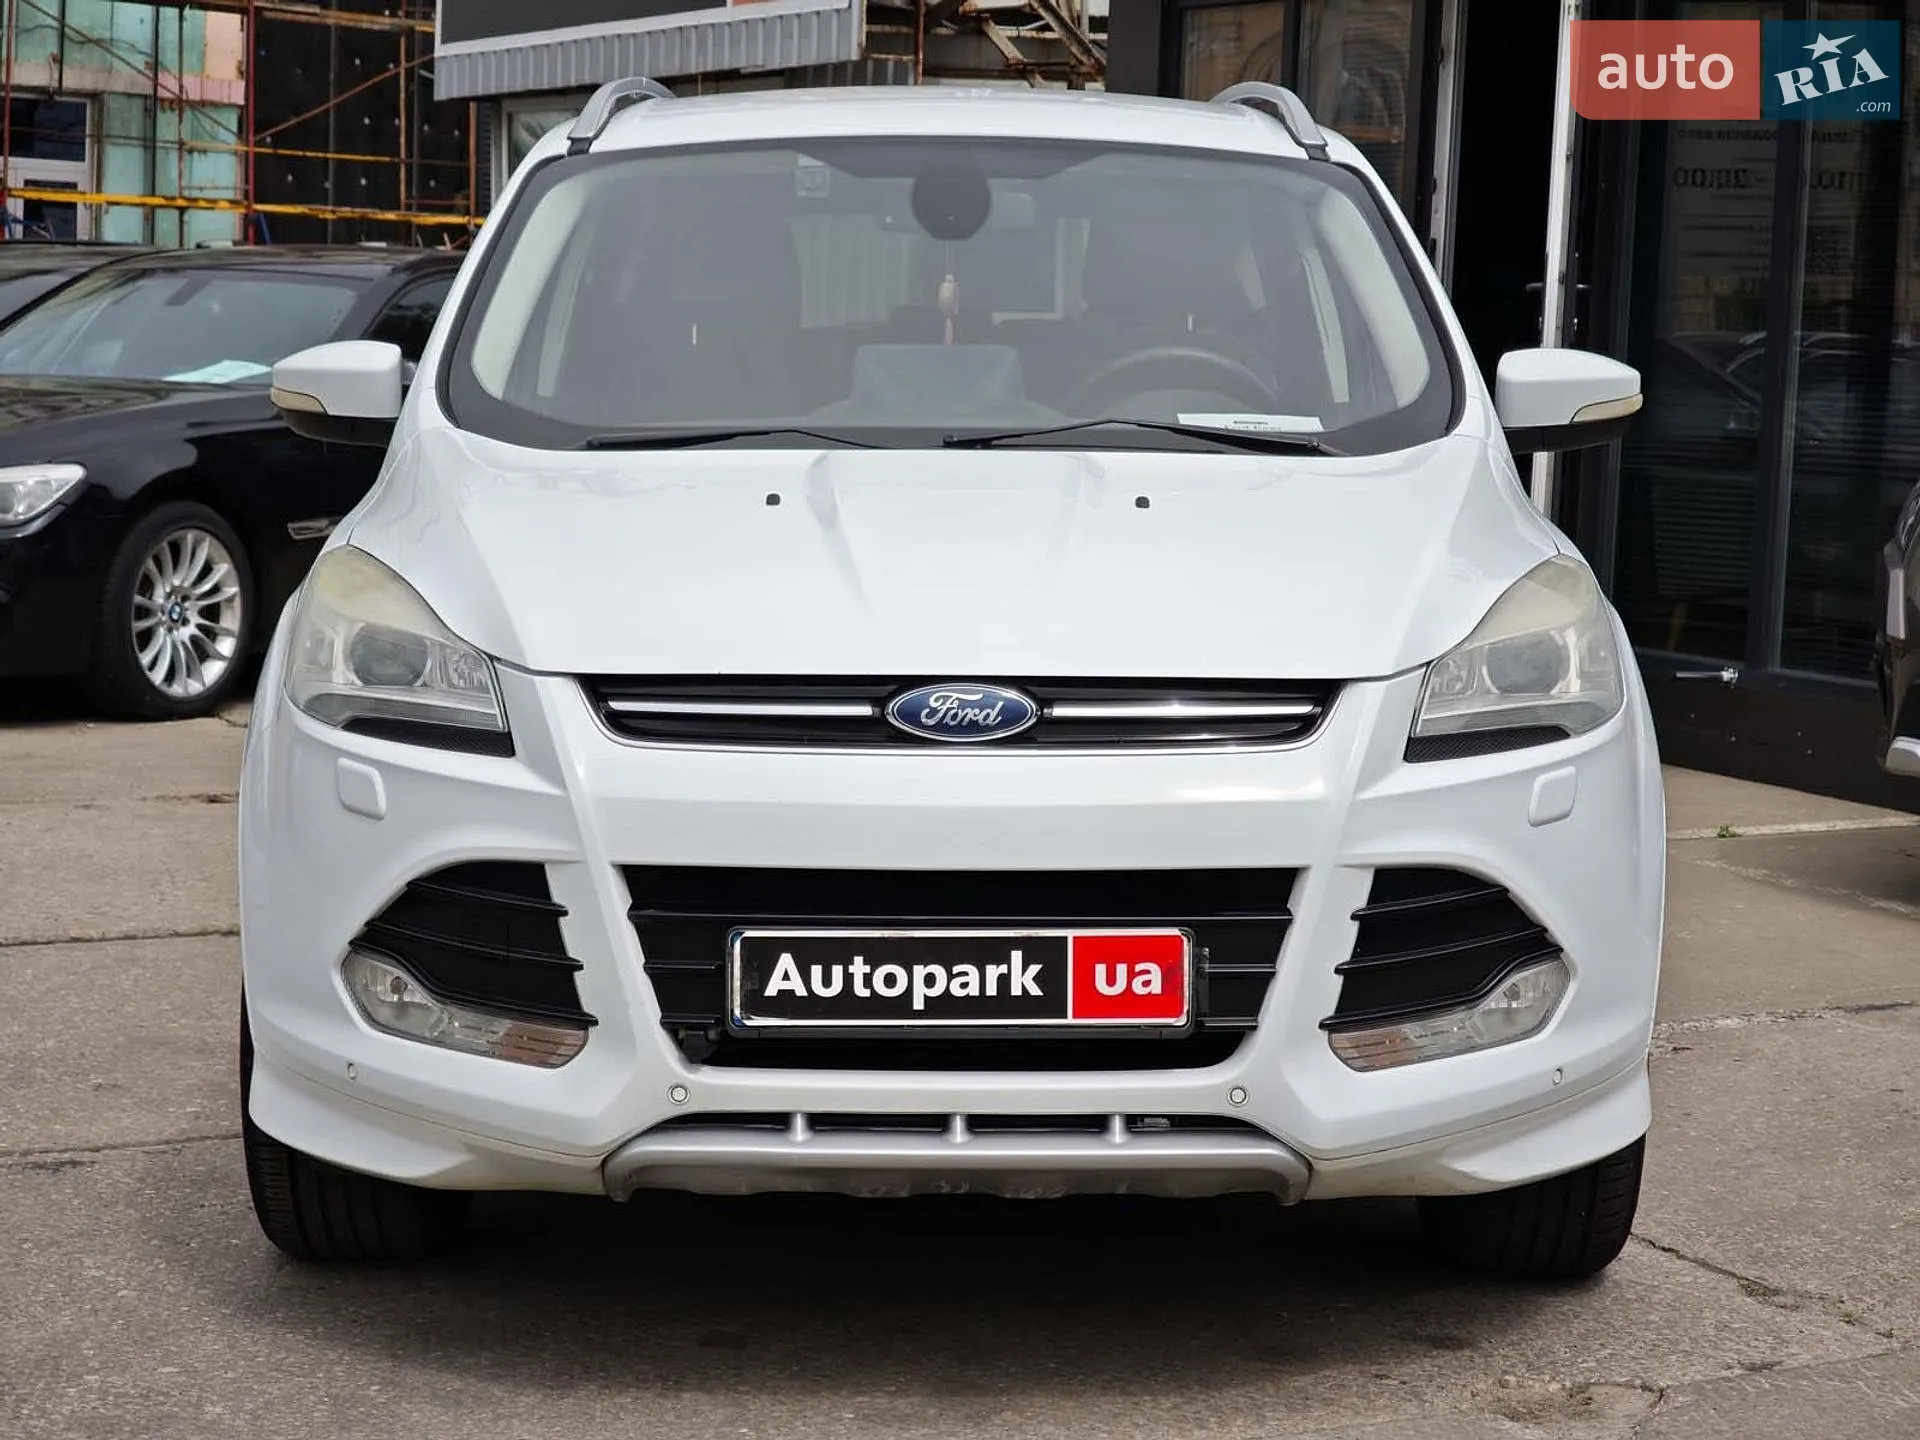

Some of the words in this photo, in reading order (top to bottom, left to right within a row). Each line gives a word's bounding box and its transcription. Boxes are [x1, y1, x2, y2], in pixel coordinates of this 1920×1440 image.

[920, 691, 1005, 727] Ford
[763, 950, 1045, 1011] Autopark
[1094, 961, 1163, 996] ua
